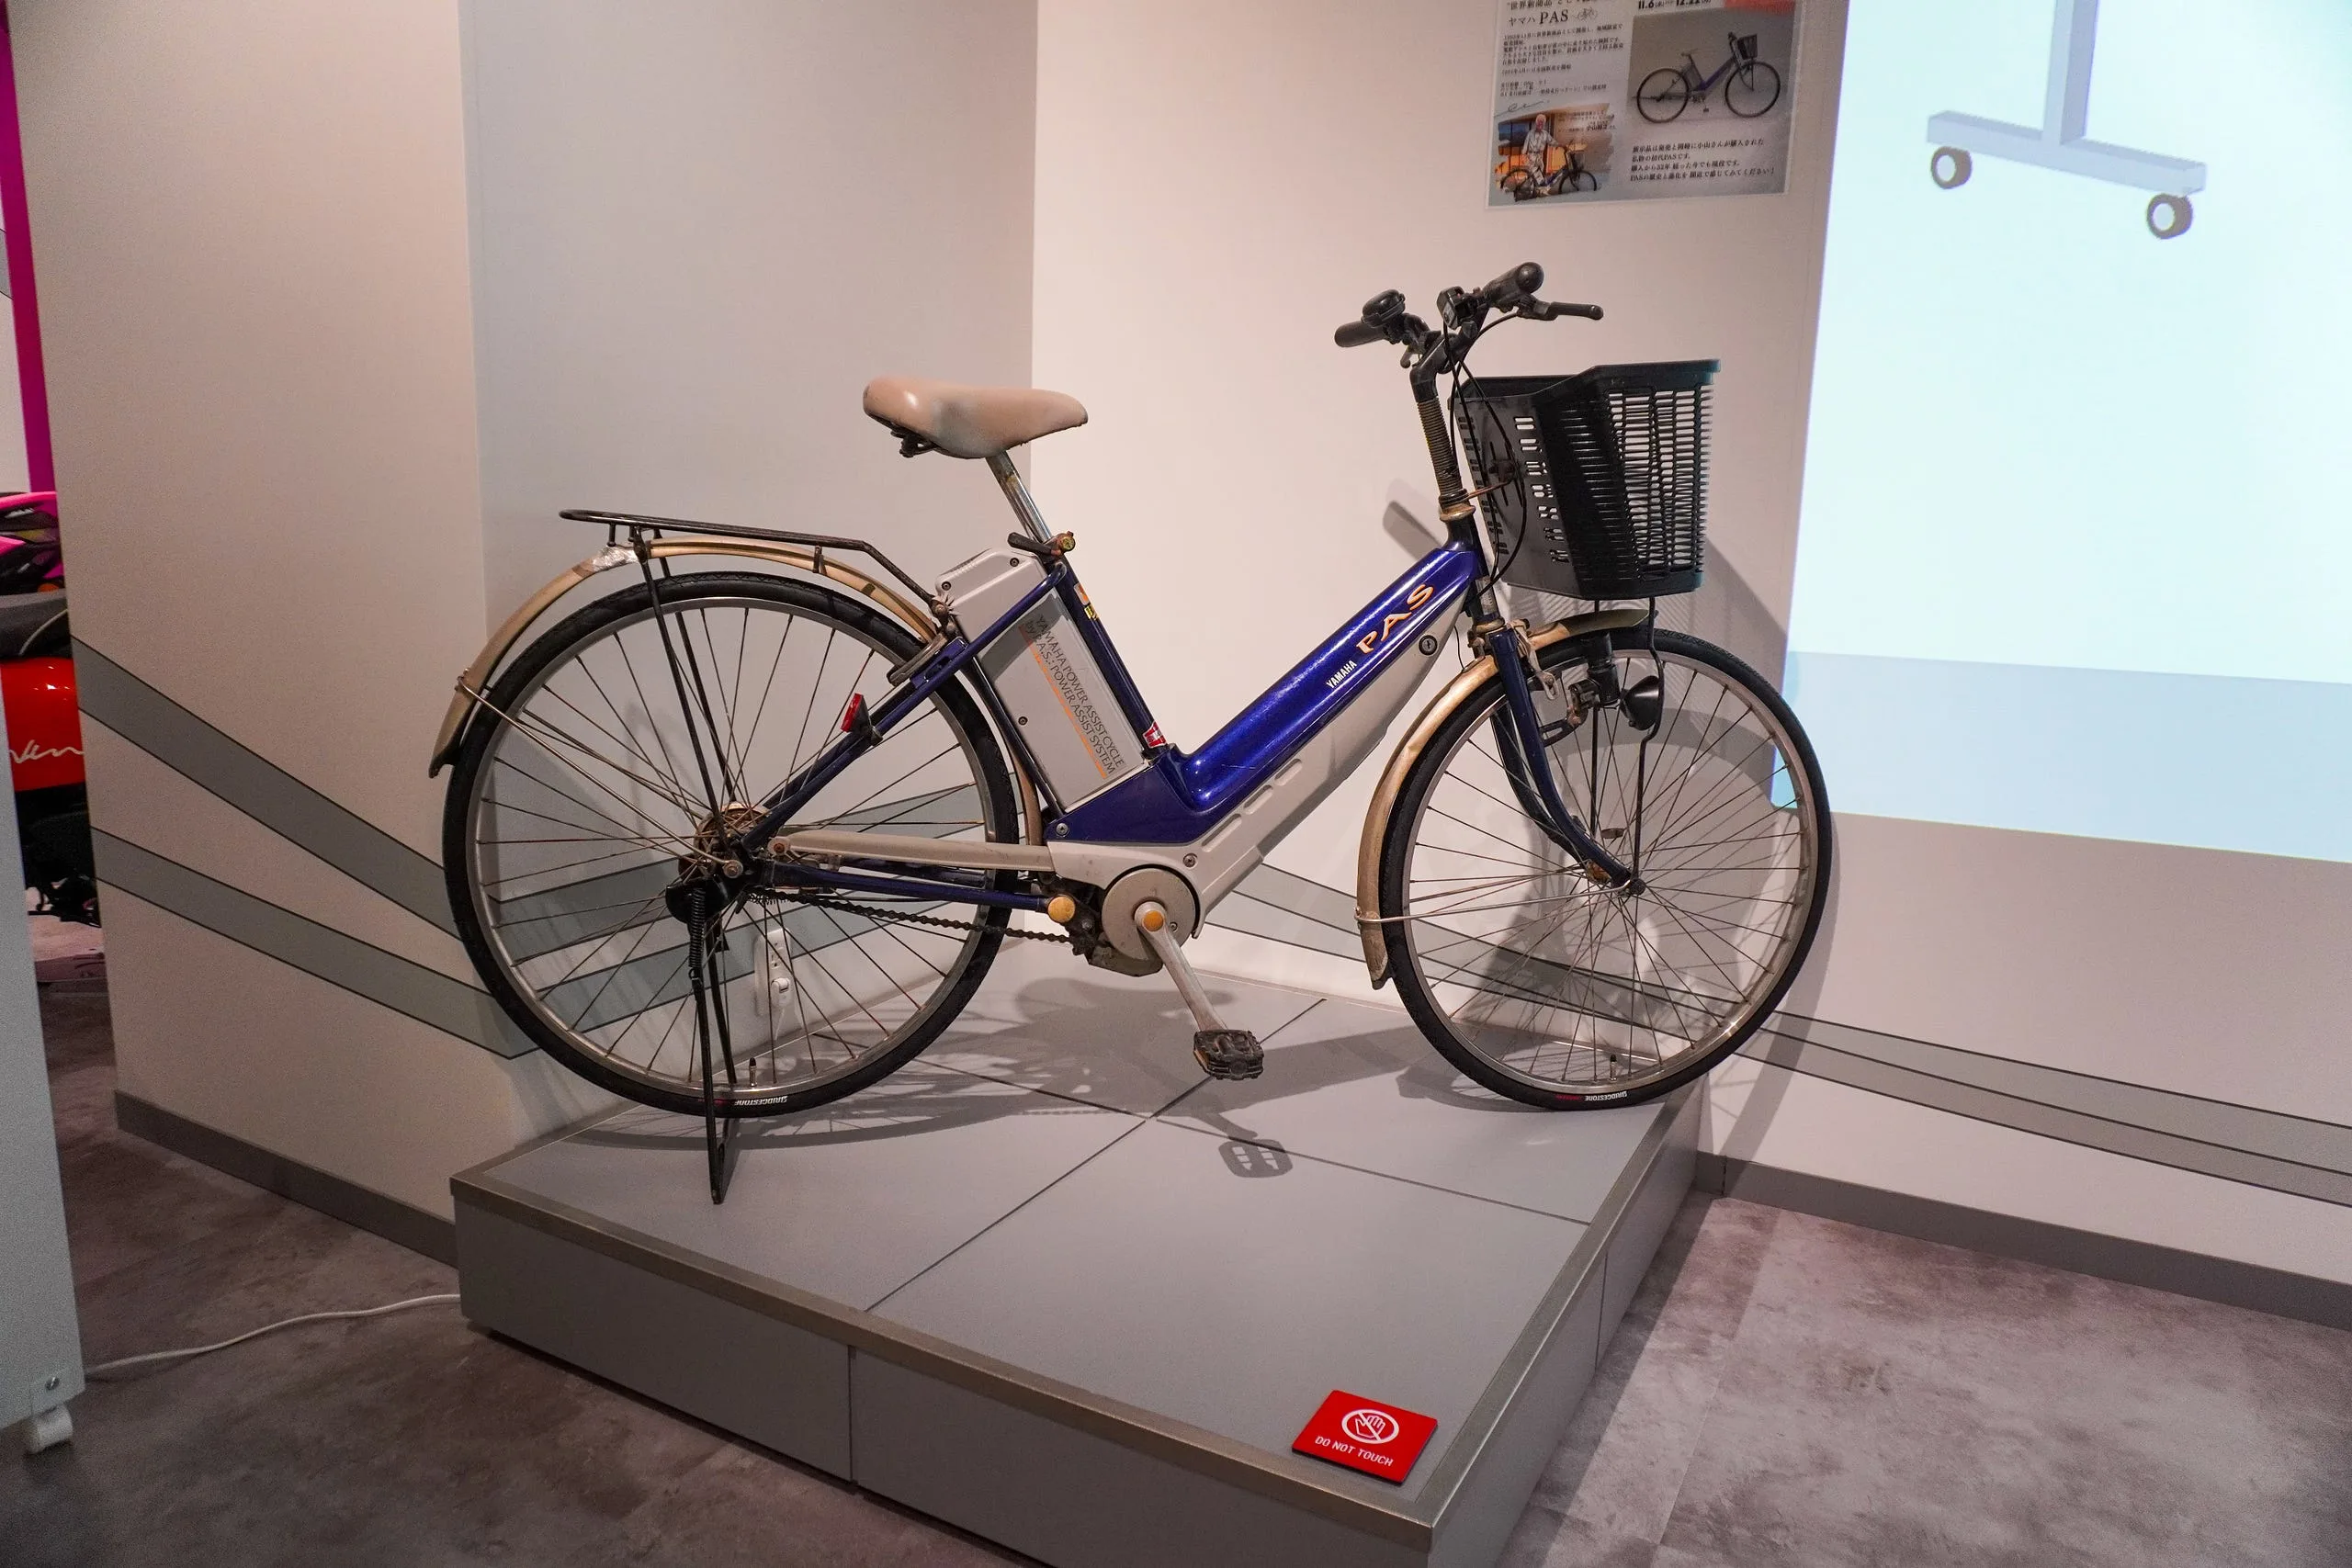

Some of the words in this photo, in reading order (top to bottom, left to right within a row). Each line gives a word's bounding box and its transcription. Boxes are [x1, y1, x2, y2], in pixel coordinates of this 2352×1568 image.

[1509, 17, 1535, 27] ヤマハ
[1539, 9, 1568, 25] PAS
[1356, 583, 1434, 654] PAS
[1035, 615, 1067, 669] YAMAHA
[1063, 665, 1089, 704] POWER
[1083, 704, 1108, 736] ASSIST
[1102, 736, 1125, 768] CYCLE
[1326, 660, 1358, 689] YAMAHA
[1050, 666, 1076, 705] POWER
[1071, 704, 1095, 736] ASSIST
[1090, 735, 1116, 773] SYSTEM
[1315, 1436, 1331, 1448] DO
[1331, 1441, 1356, 1455] NOT
[1357, 1449, 1395, 1467] TOUCH
